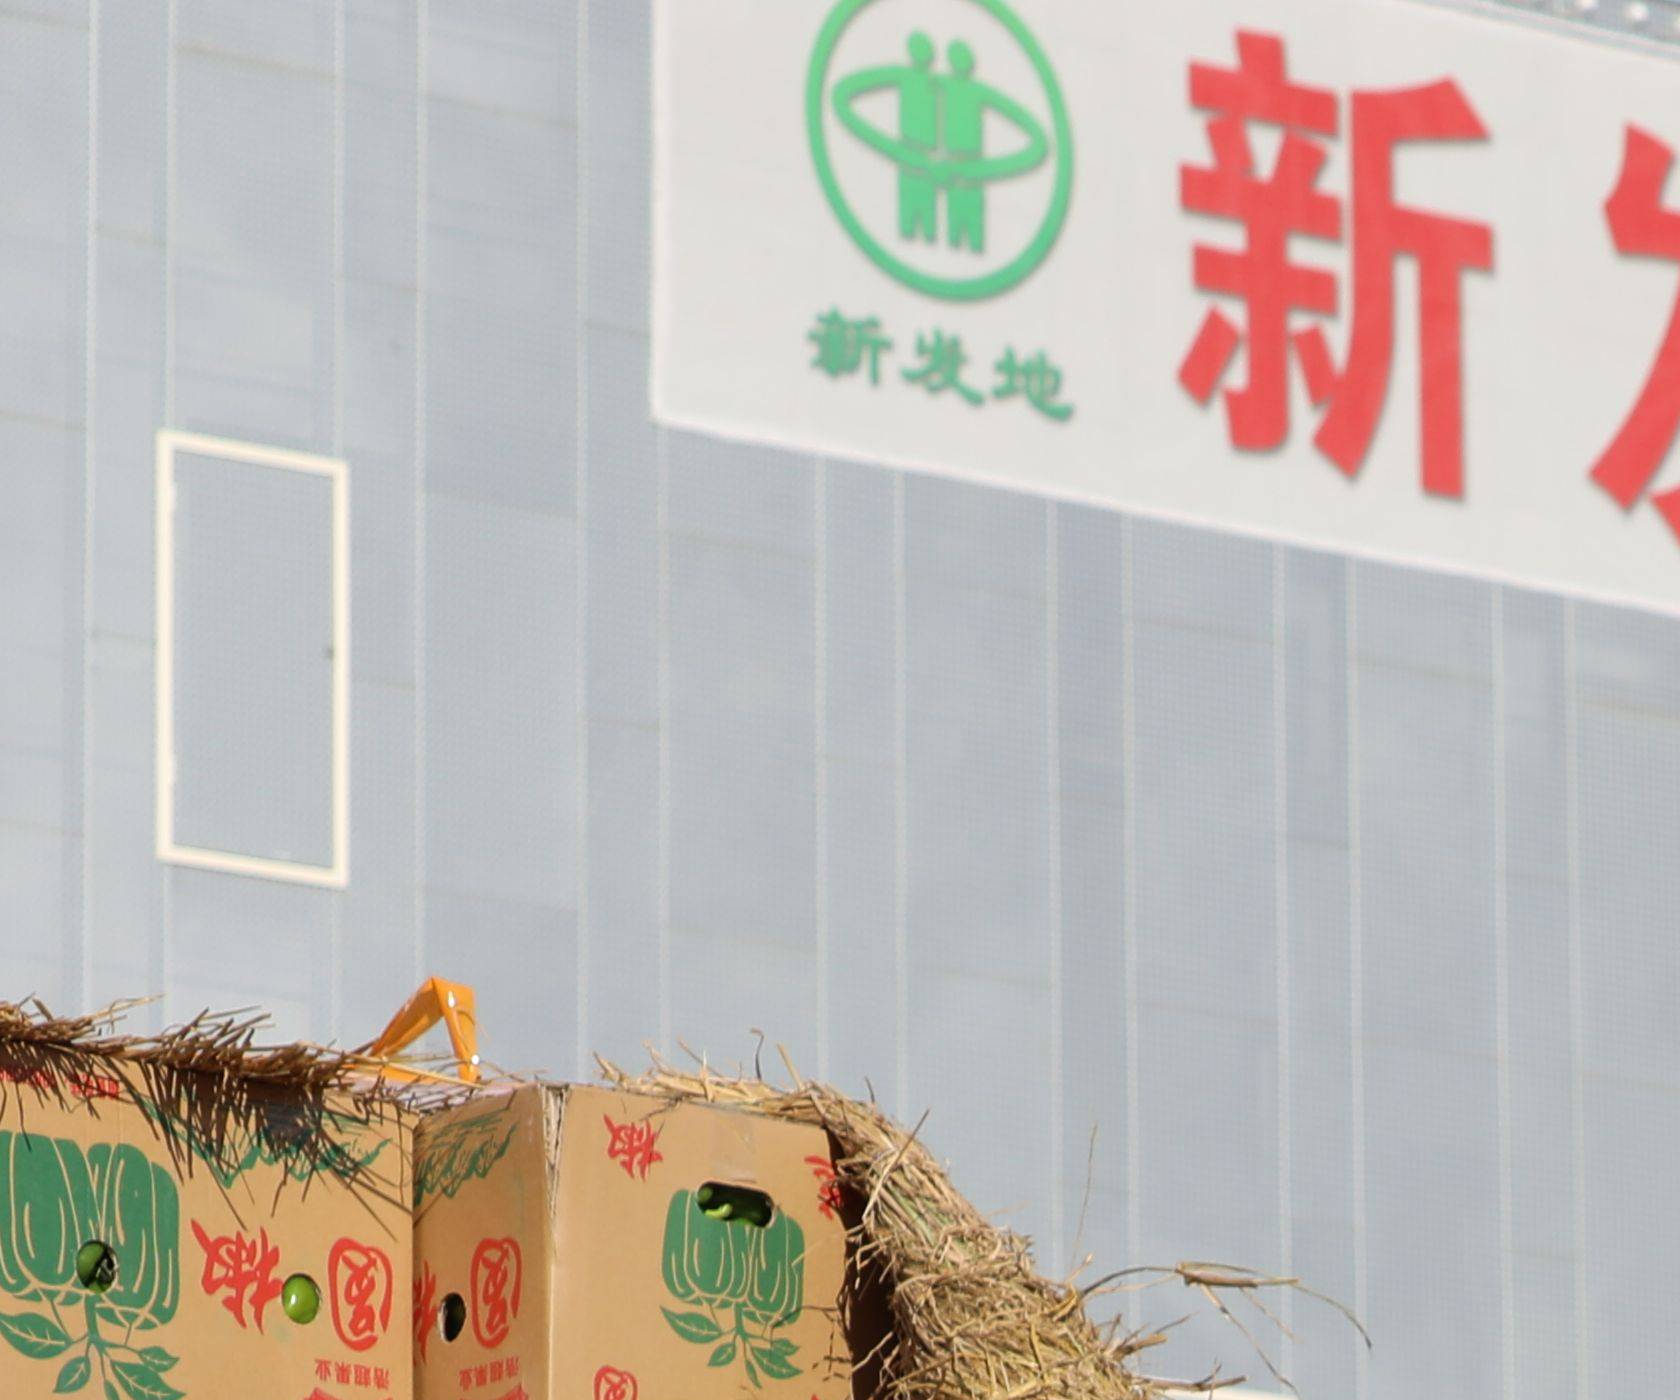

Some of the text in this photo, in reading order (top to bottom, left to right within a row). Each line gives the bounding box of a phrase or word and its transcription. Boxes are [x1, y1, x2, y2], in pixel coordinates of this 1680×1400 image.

[807, 306, 1074, 424] 新发地
[604, 1116, 663, 1177] 椒
[191, 1221, 393, 1352] 圆椒
[316, 1360, 389, 1389] 浩超果业
